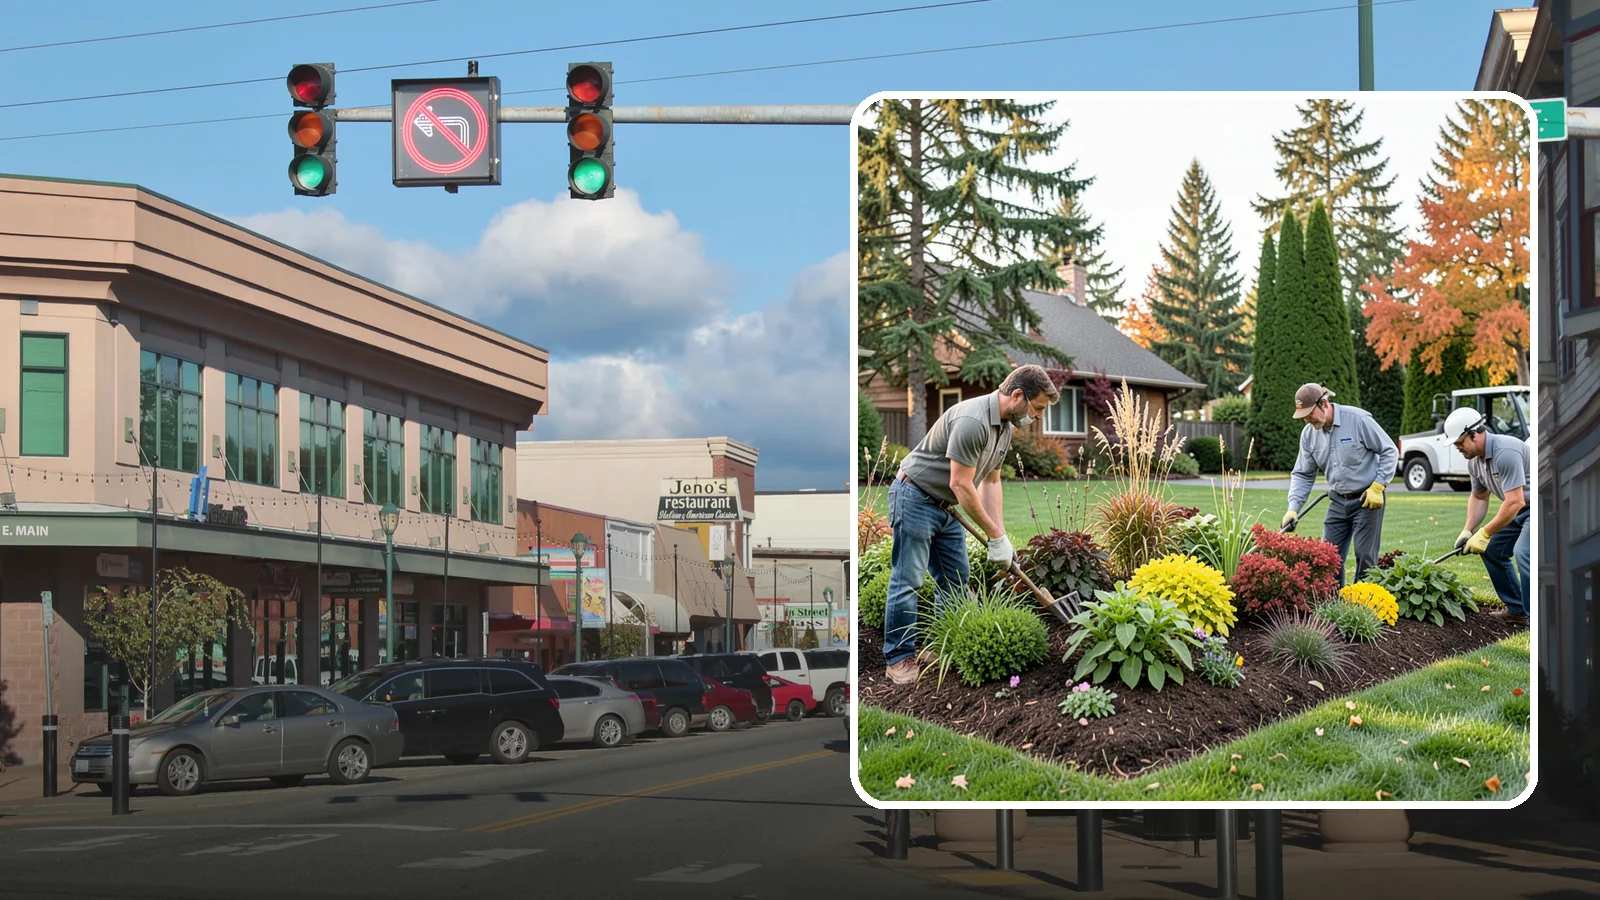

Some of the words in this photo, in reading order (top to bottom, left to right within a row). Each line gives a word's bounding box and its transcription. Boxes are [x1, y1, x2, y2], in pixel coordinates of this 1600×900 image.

[670, 480, 727, 494] Jeno's
[664, 496, 731, 509] restaurant
[658, 510, 681, 519] Italian
[685, 509, 714, 519] American
[714, 509, 738, 519] Cuisine
[2, 525, 13, 536] E.
[15, 525, 49, 536] MAIN
[797, 608, 828, 617] Street
